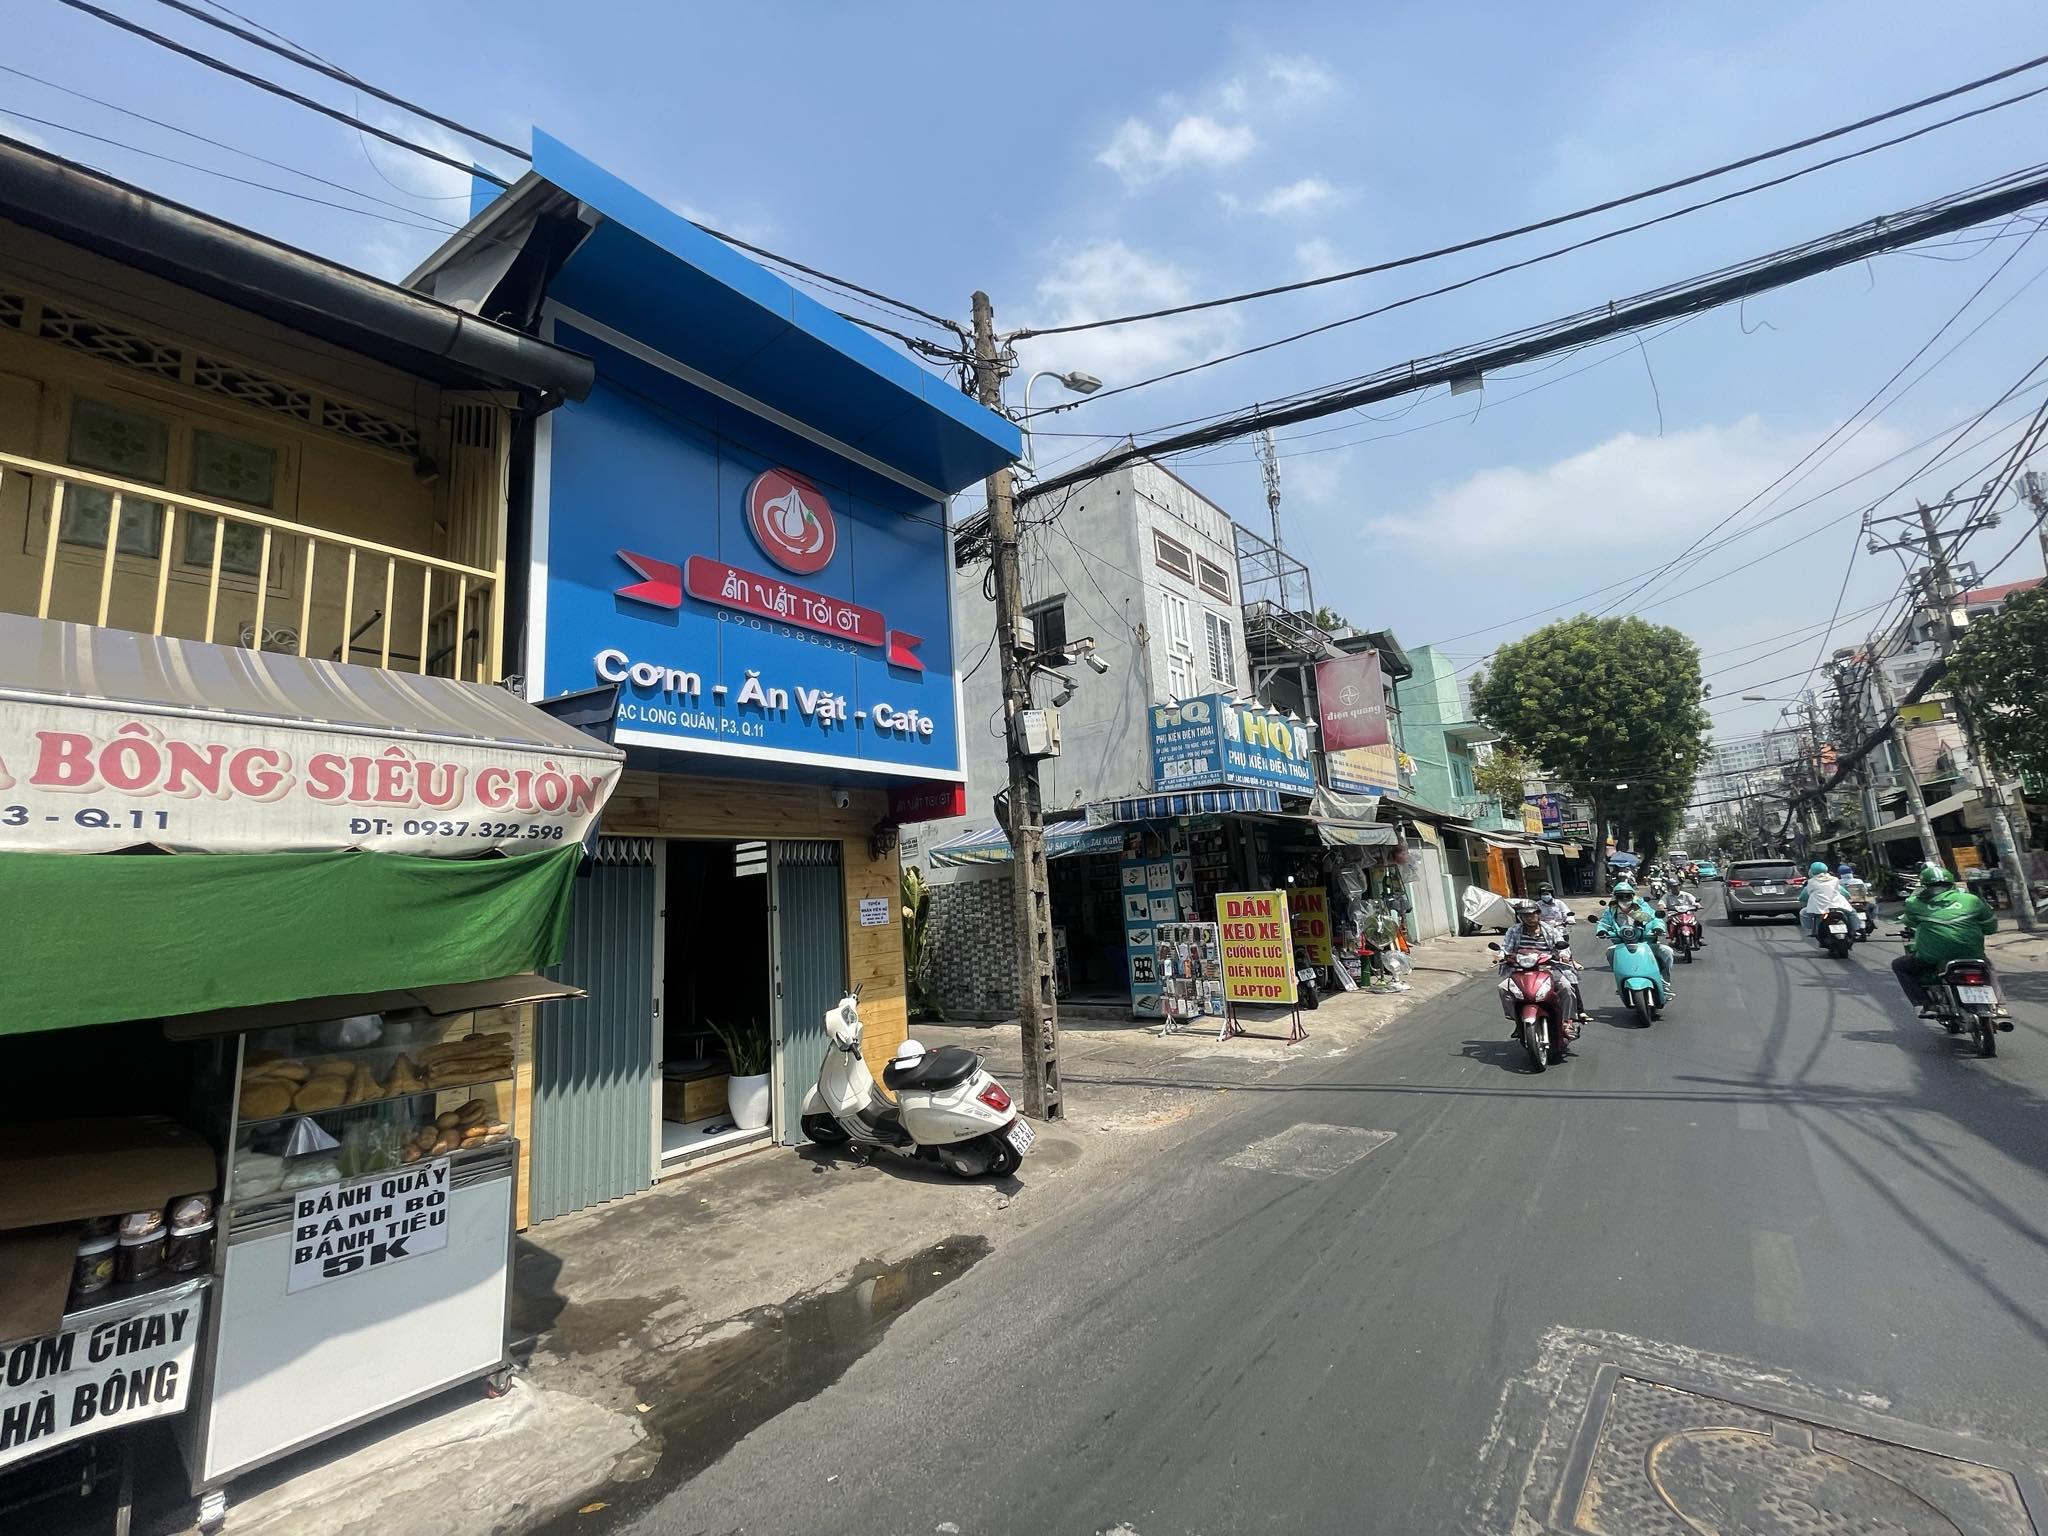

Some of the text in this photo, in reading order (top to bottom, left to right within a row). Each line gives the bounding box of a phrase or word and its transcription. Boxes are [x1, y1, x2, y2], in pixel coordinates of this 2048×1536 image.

[594, 649, 700, 696] Cơm
[737, 669, 788, 709] Ăn
[795, 687, 847, 725] Vặt
[873, 703, 934, 735] Cafe
[640, 707, 676, 726] LONG
[682, 711, 718, 732] QUÂN,
[742, 722, 764, 738] Q.11
[1155, 702, 1210, 728] HQ
[1243, 711, 1294, 760] HQ
[29, 722, 288, 799] BÔNG
[306, 746, 460, 806] SIÊU
[475, 761, 602, 813] GIÒN
[1228, 750, 1246, 769] PHỤ
[1248, 753, 1268, 773] KIỆN
[1289, 764, 1310, 781] THOẠI
[74, 808, 168, 829] Q.11
[350, 818, 563, 840] ĐT: 0937.322.598
[1226, 896, 1271, 917] DÁN
[1223, 923, 1281, 940] KEO XE
[1226, 944, 1260, 959] CƯỜNG
[1263, 945, 1282, 961] LỰC
[1228, 963, 1252, 980] ĐIỆN
[1254, 965, 1285, 981] THOẠI
[1233, 985, 1282, 997] LAPTOP
[298, 1164, 447, 1219] BÁNH QUẨY
[297, 1190, 445, 1242] BÁNH BÒ
[295, 1209, 445, 1264] BÁNH TIÊU
[0, 1309, 189, 1387] ƠM CHAY
[70, 1361, 178, 1427] BÔNG
